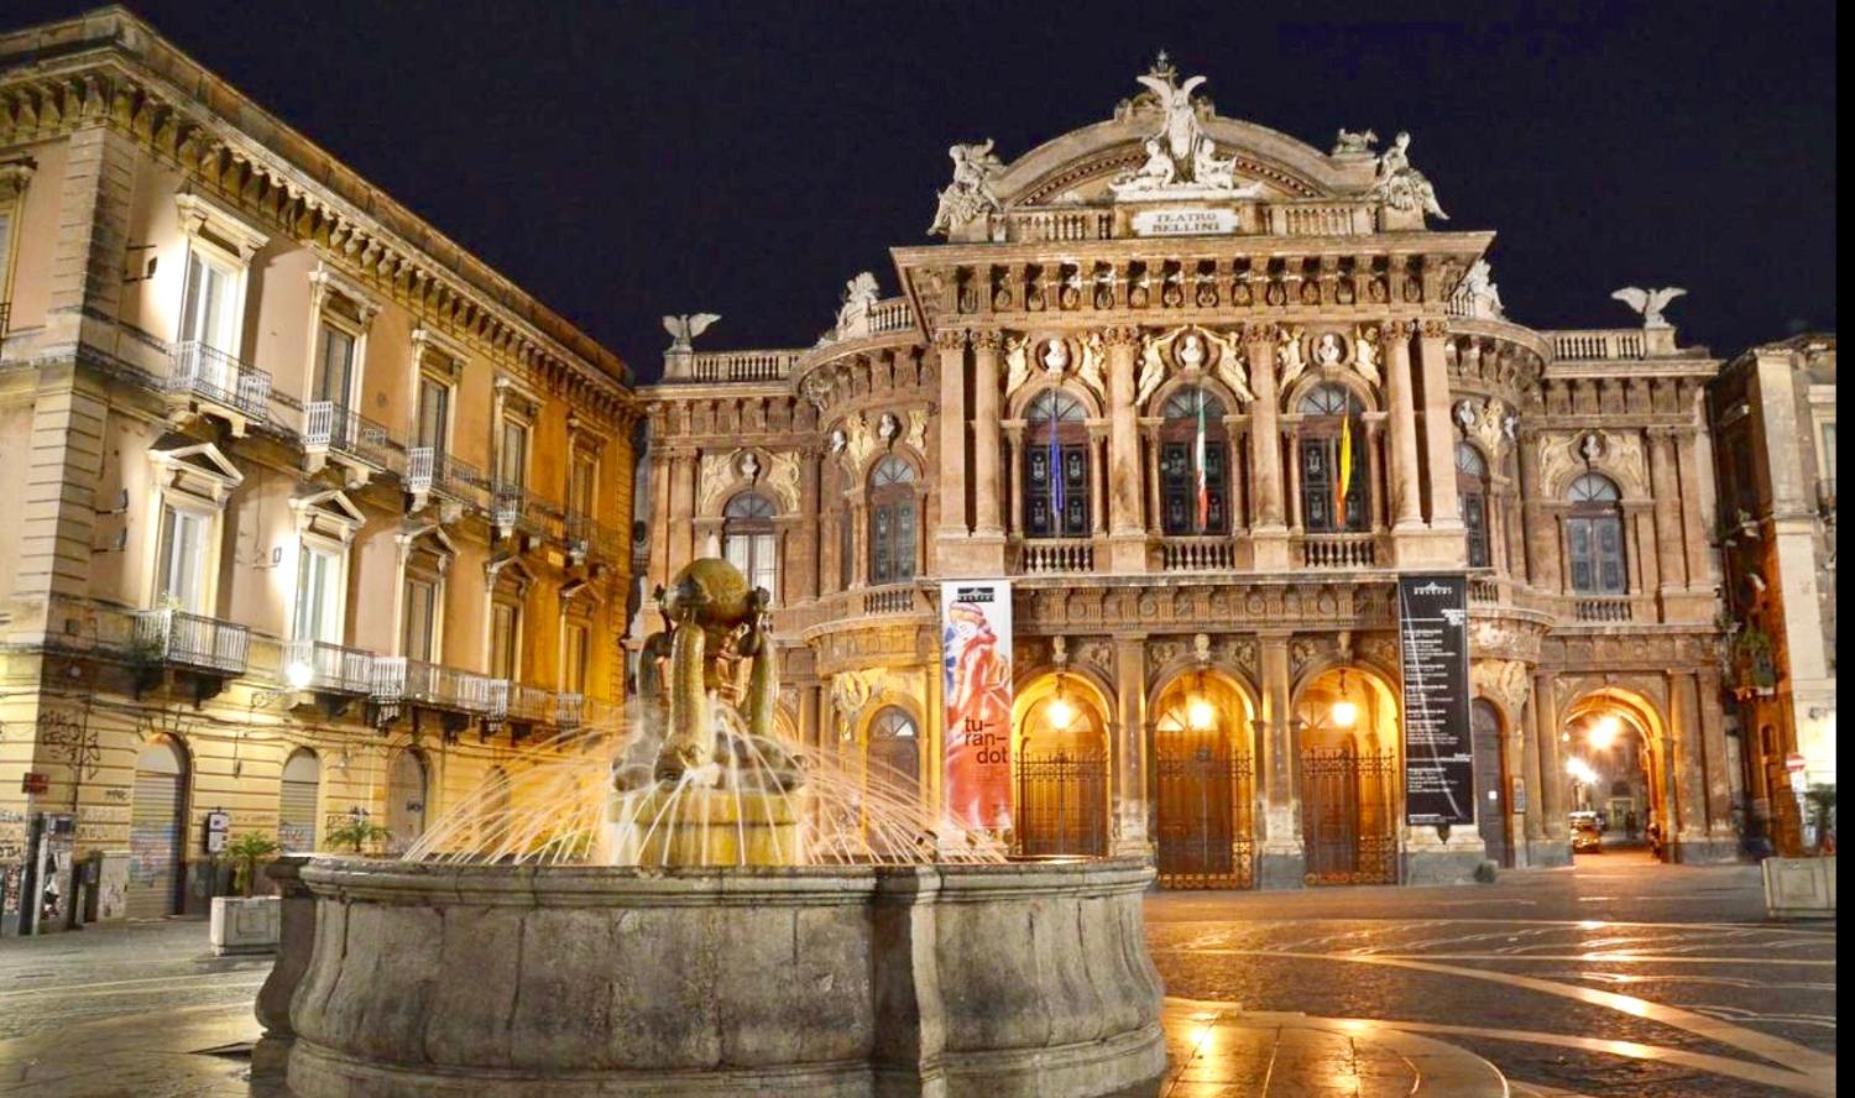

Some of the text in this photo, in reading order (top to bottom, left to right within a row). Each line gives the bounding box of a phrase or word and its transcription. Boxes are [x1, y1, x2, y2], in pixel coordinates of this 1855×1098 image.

[1156, 213, 1217, 223] TEATRO
[1152, 222, 1220, 232] BELLINI
[965, 733, 1007, 746] ran-
[976, 747, 1008, 764] dot
